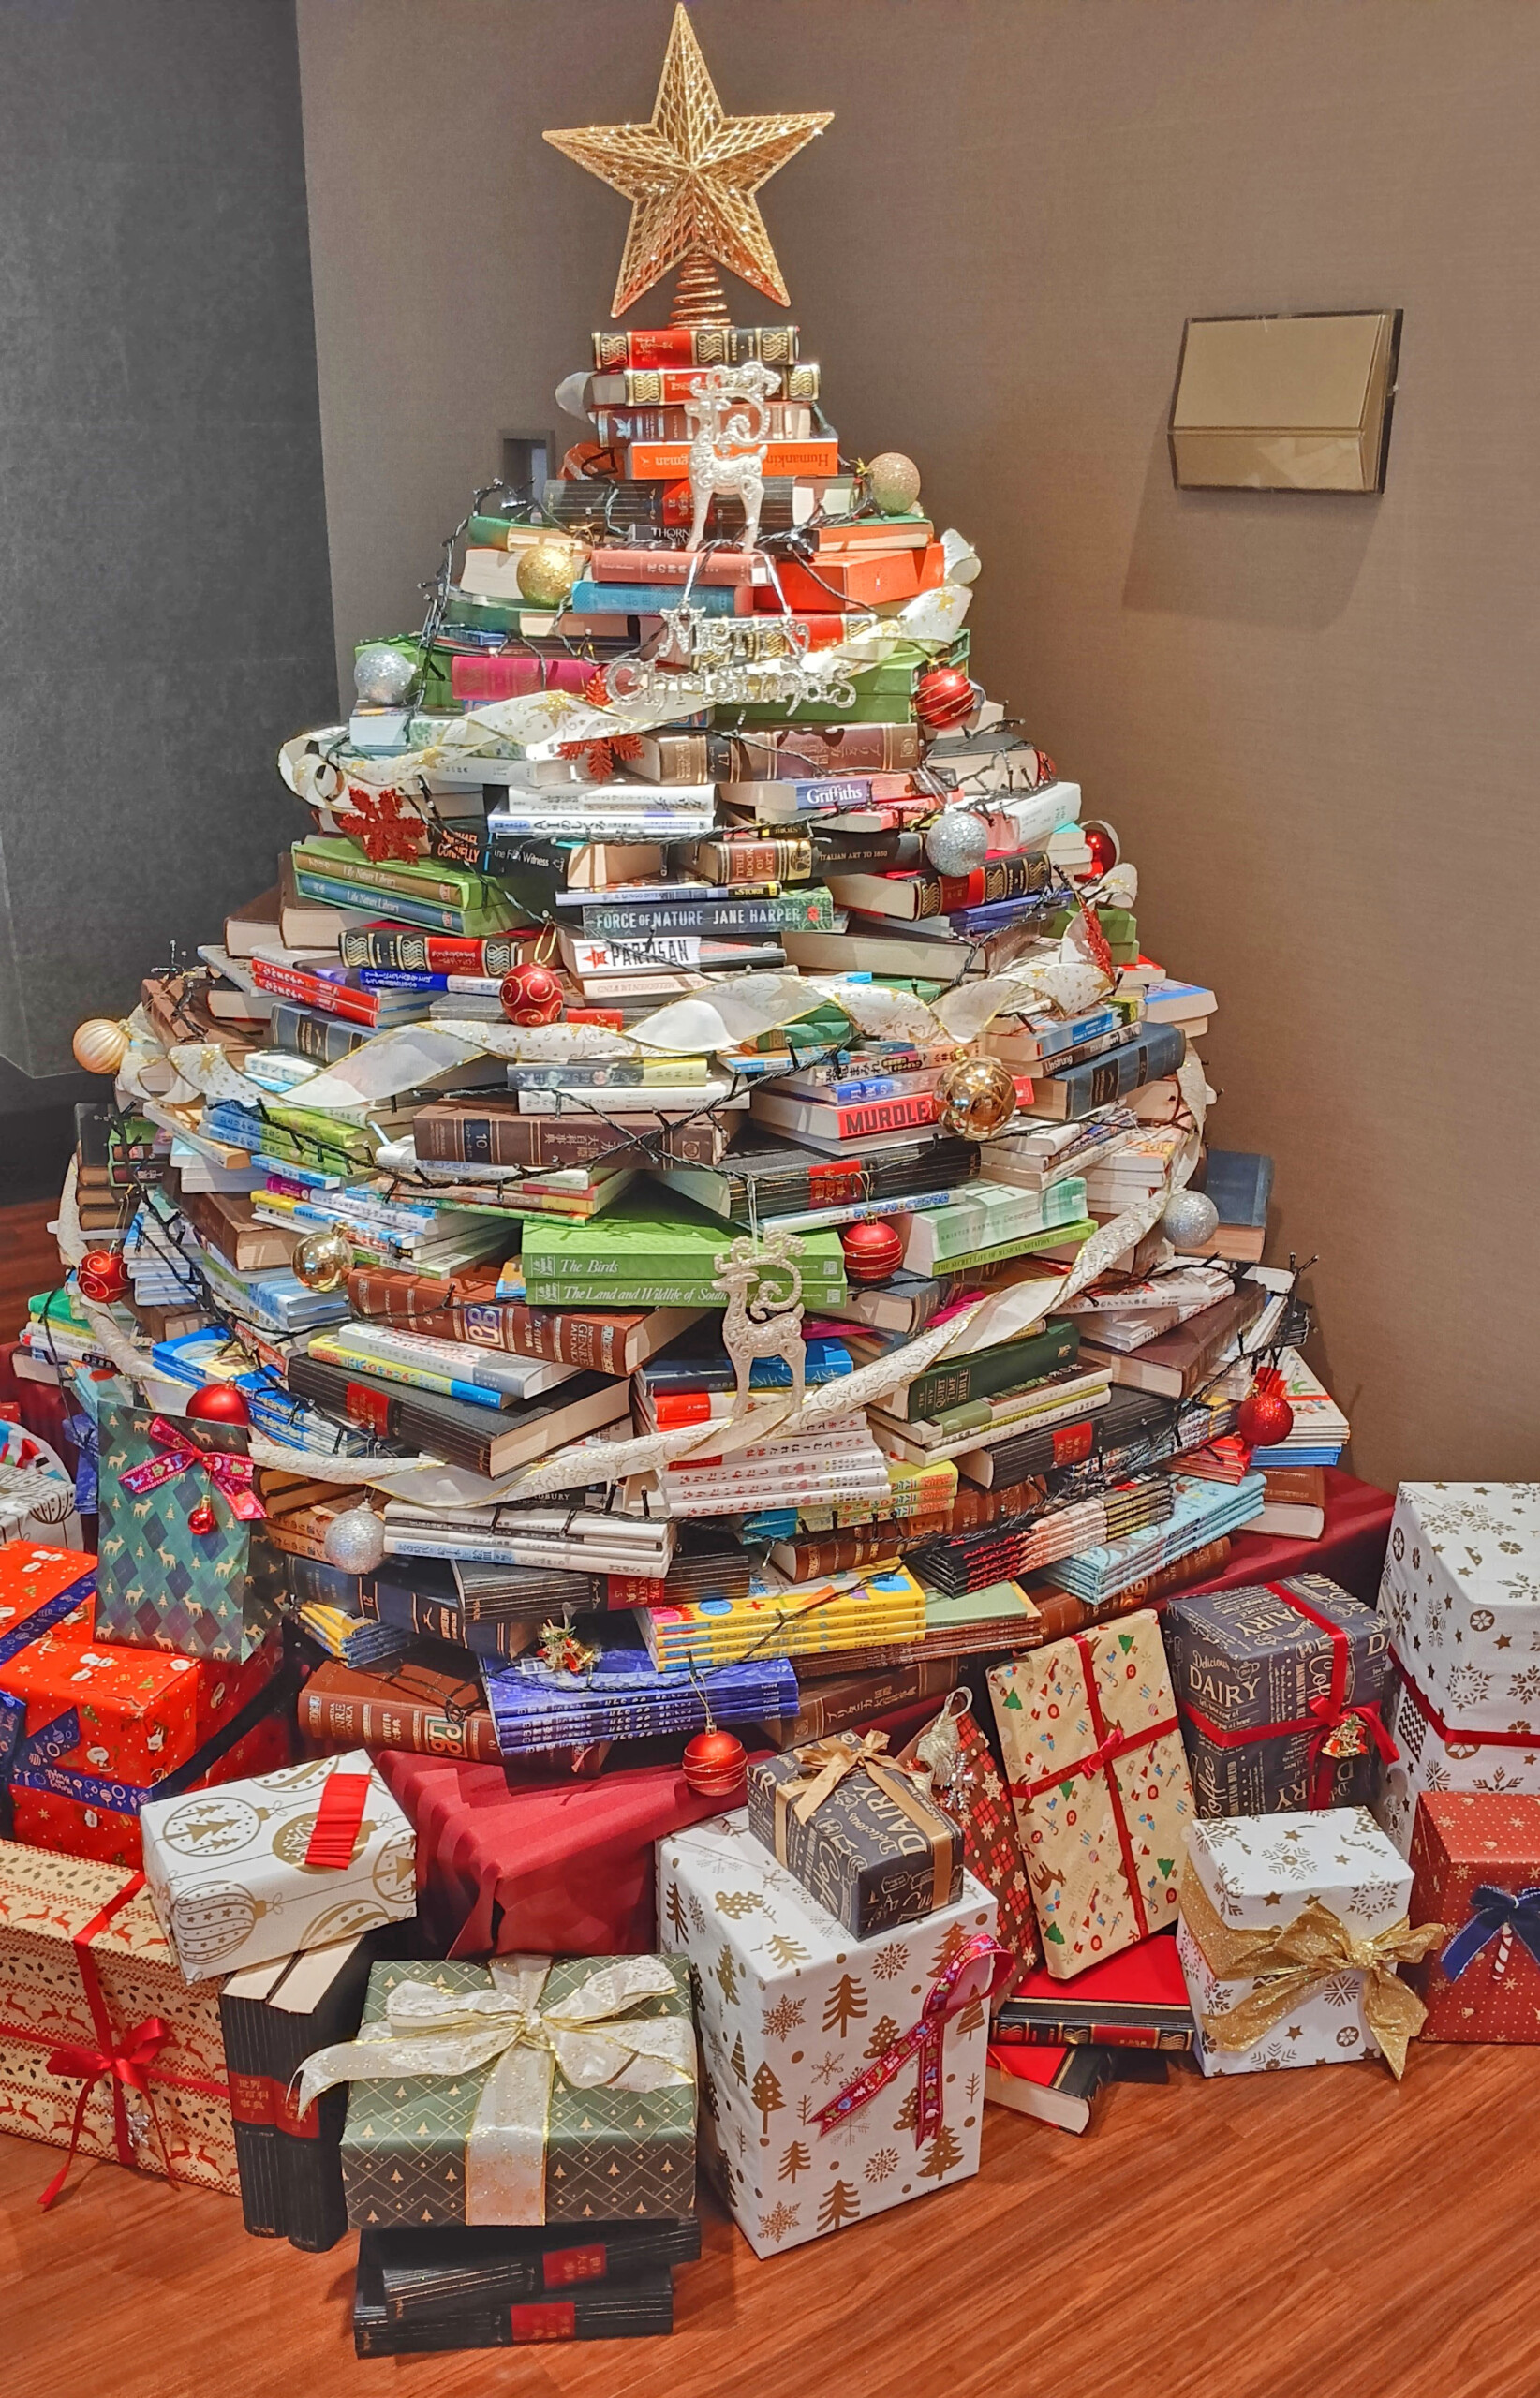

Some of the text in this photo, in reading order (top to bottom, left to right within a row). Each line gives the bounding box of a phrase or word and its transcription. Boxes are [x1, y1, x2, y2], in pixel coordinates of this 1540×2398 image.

[765, 452, 830, 468] Humankin
[657, 606, 810, 661] Merry
[606, 658, 856, 718] Christmas
[806, 782, 863, 806] Griffiths
[522, 851, 550, 867] Witness
[848, 851, 862, 860] ART
[863, 850, 873, 859] TO
[597, 906, 802, 929] FORCE OF NATURE JANE HARPER
[610, 940, 690, 968] PARTISAN
[846, 1100, 928, 1134] MURDLE
[475, 1132, 488, 1149] 10
[988, 1251, 998, 1260] OF
[998, 1244, 1023, 1258] MUSICAL
[1024, 1237, 1051, 1251] NOTATION
[559, 1258, 619, 1274] The Birds
[563, 1285, 585, 1300] The
[585, 1285, 616, 1300] Land
[617, 1286, 639, 1300] and
[640, 1285, 682, 1302] Wildlife
[683, 1286, 694, 1303] of
[577, 1323, 588, 1366] GENRE
[935, 1378, 947, 1409] QUIET
[946, 1375, 957, 1402] TIME
[957, 1368, 970, 1401] BIBLE
[1192, 1650, 1231, 1672] Delicious
[1189, 1664, 1262, 1708] DAIRY
[852, 1784, 928, 1857] DAIRY
[847, 1813, 900, 1856] Delicious
